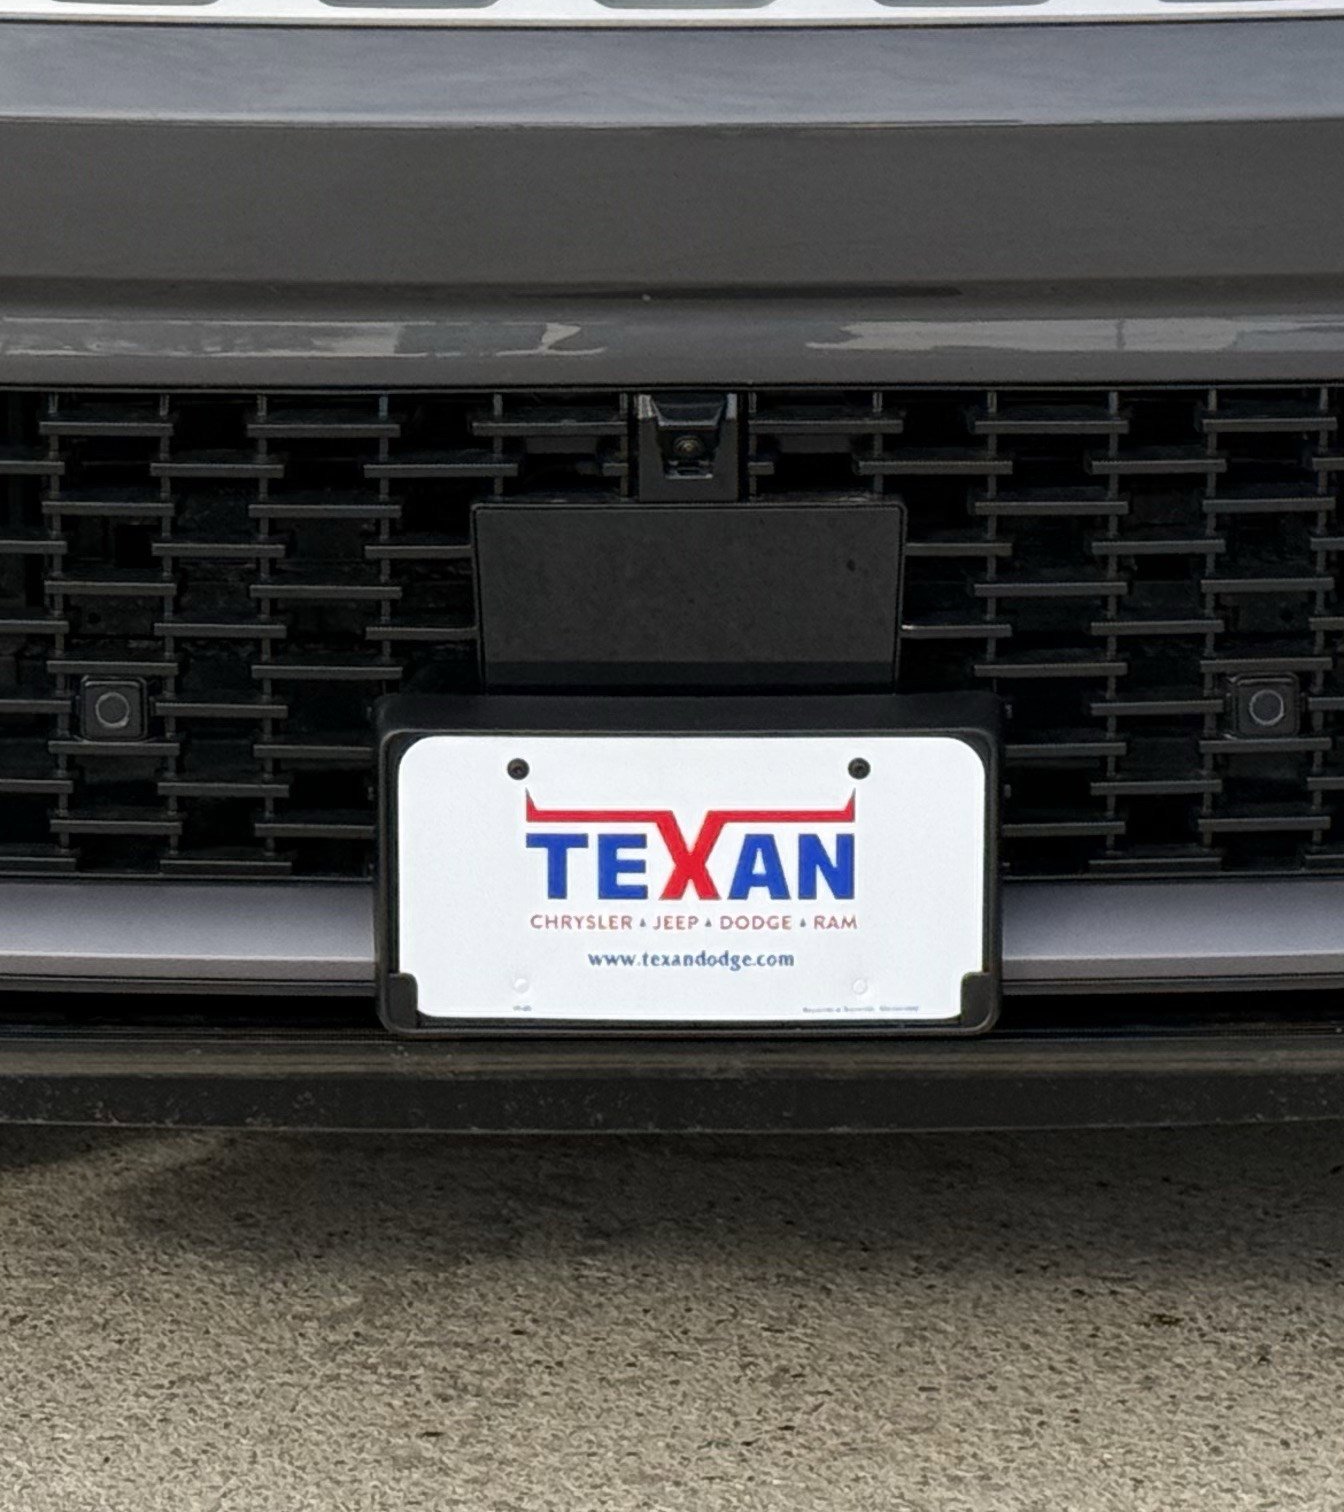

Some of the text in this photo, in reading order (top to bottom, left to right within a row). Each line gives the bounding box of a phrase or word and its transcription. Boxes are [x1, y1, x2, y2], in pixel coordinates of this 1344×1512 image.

[525, 804, 857, 901] TEXAN
[529, 913, 858, 931] CHRYSLER JEEP DODGE RAM
[587, 949, 796, 972] www.texandodge.com
